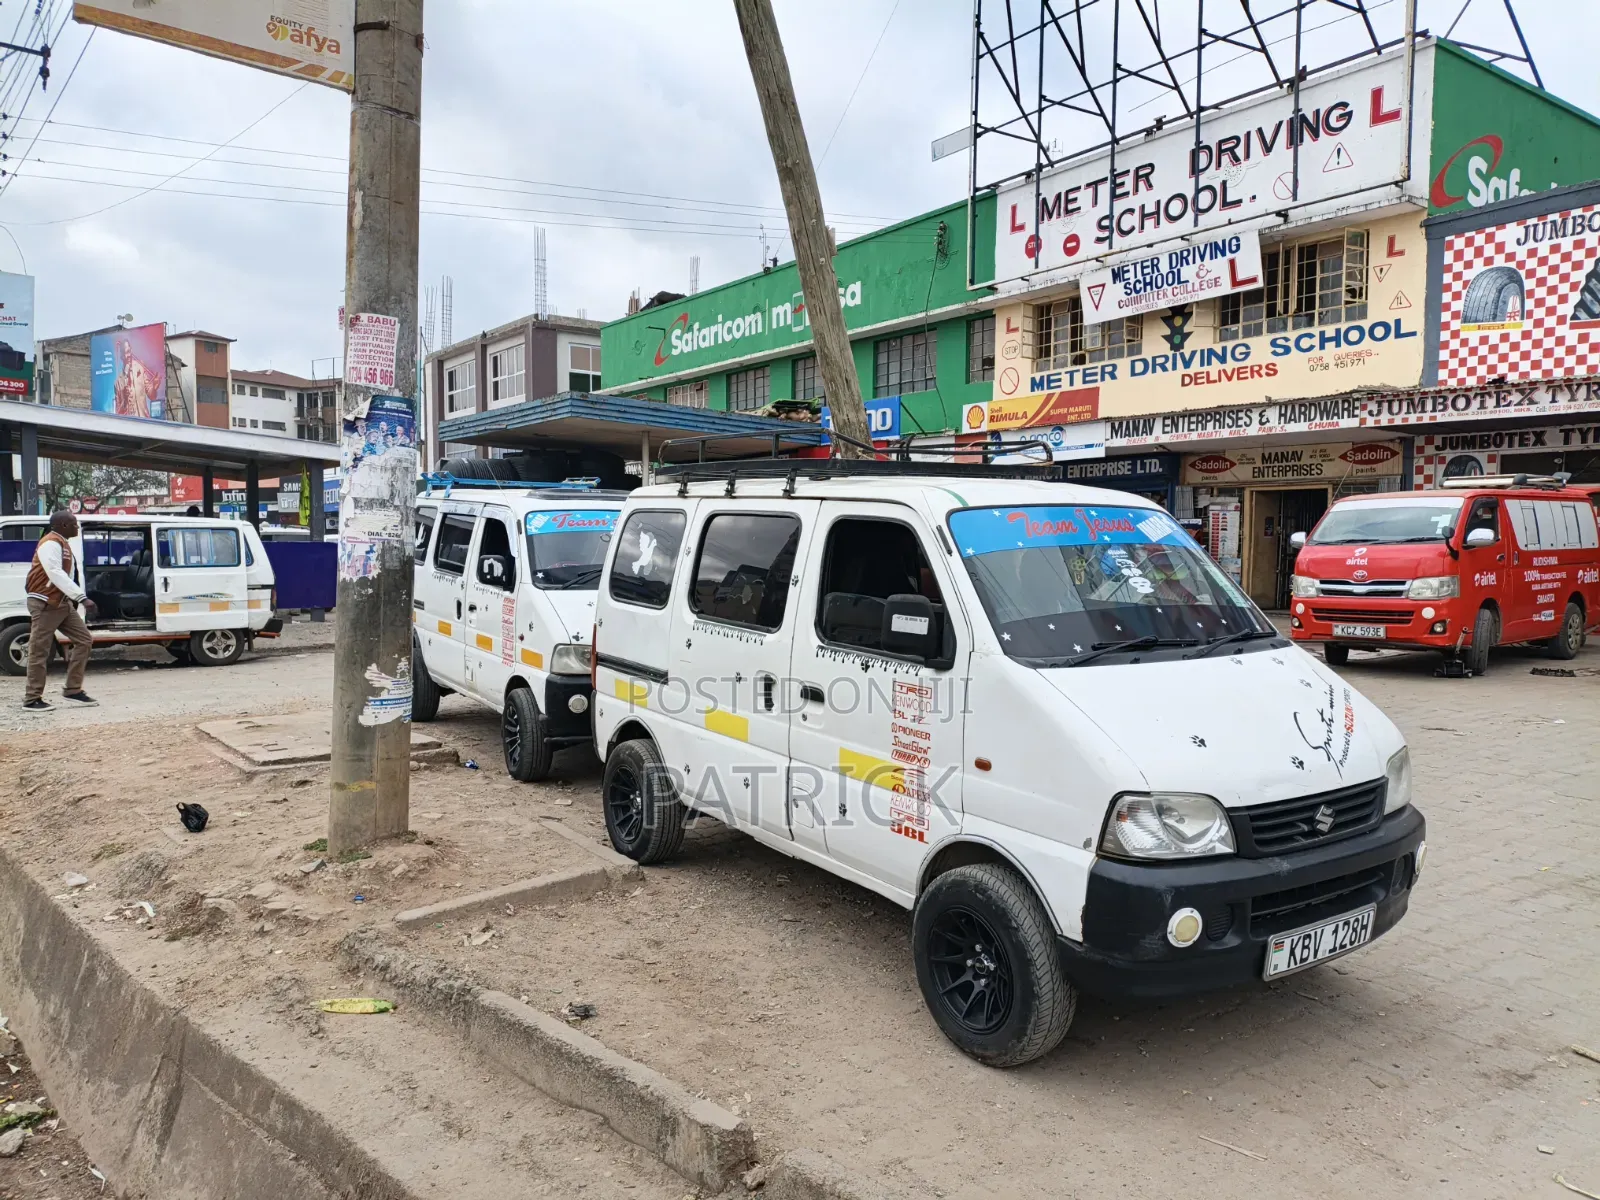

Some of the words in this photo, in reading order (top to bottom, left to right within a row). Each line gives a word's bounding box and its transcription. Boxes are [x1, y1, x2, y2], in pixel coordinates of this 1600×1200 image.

[270, 15, 304, 30] EQUITY
[289, 26, 341, 54] afya
[1370, 85, 1402, 128] L
[1039, 163, 1155, 225] METER
[1189, 101, 1354, 179] DRIVING
[1009, 203, 1027, 235] L
[1387, 234, 1405, 258] L
[1111, 256, 1161, 285] METER
[1168, 235, 1241, 269] DRIVING
[1123, 268, 1190, 296] SCHOOL
[1227, 257, 1259, 290] L
[1117, 288, 1169, 310] COMPUTER
[1171, 276, 1222, 296] COLLEGE
[367, 315, 396, 327] BABU
[1006, 316, 1019, 334] L
[372, 336, 395, 344] ITEMS
[671, 312, 762, 356] Safaricom
[353, 342, 395, 351] SPIRITUALIST
[369, 349, 394, 357] POWER
[1004, 345, 1018, 355] STOP
[353, 354, 394, 363] PROTECTION
[1030, 363, 1118, 393] METER
[1130, 342, 1251, 377] DRIVING
[1270, 318, 1417, 357] SCHOOL
[1308, 356, 1324, 365] FOR
[352, 361, 393, 369] PROMOTION
[1309, 362, 1330, 372] 0758
[363, 368, 378, 384] 456
[379, 368, 394, 387] 966
[1180, 362, 1279, 388] DELIVERS
[1050, 407, 1068, 416] SUPER
[1069, 405, 1092, 413] MARUTI
[1368, 387, 1540, 418] JUMBOTEX
[989, 411, 1028, 423] RIMULA
[1110, 417, 1156, 439] MANAV
[1161, 408, 1253, 435] ENTERPRISES
[1278, 399, 1360, 425] HARDWARE
[1307, 421, 1340, 430] CHUMA
[1434, 430, 1548, 452] JUMBOTEX
[1261, 450, 1304, 465] MANAV
[1346, 448, 1392, 462] Sadolin
[1067, 460, 1132, 479] ENTERPRISE
[1195, 460, 1231, 470] Sadolin
[1252, 463, 1324, 479] ENTERPRISES
[1355, 466, 1377, 475] paints
[551, 513, 608, 529] Team
[1007, 511, 1079, 538] Team
[1075, 508, 1136, 541] Jesus
[1345, 557, 1369, 566] airtel
[1480, 571, 1497, 586] airtel
[1524, 570, 1540, 582] 100%
[1584, 567, 1600, 583] airtel
[1341, 625, 1358, 636] KCZ
[1360, 626, 1382, 637] 593E
[892, 694, 932, 714] KENWOOD
[1344, 703, 1354, 733] SUZUKI
[898, 725, 931, 742] PIONEER
[890, 793, 932, 816] KENWOOD
[890, 821, 930, 845] JBL
[1287, 928, 1326, 969] KBV
[1328, 912, 1371, 954] 128H
